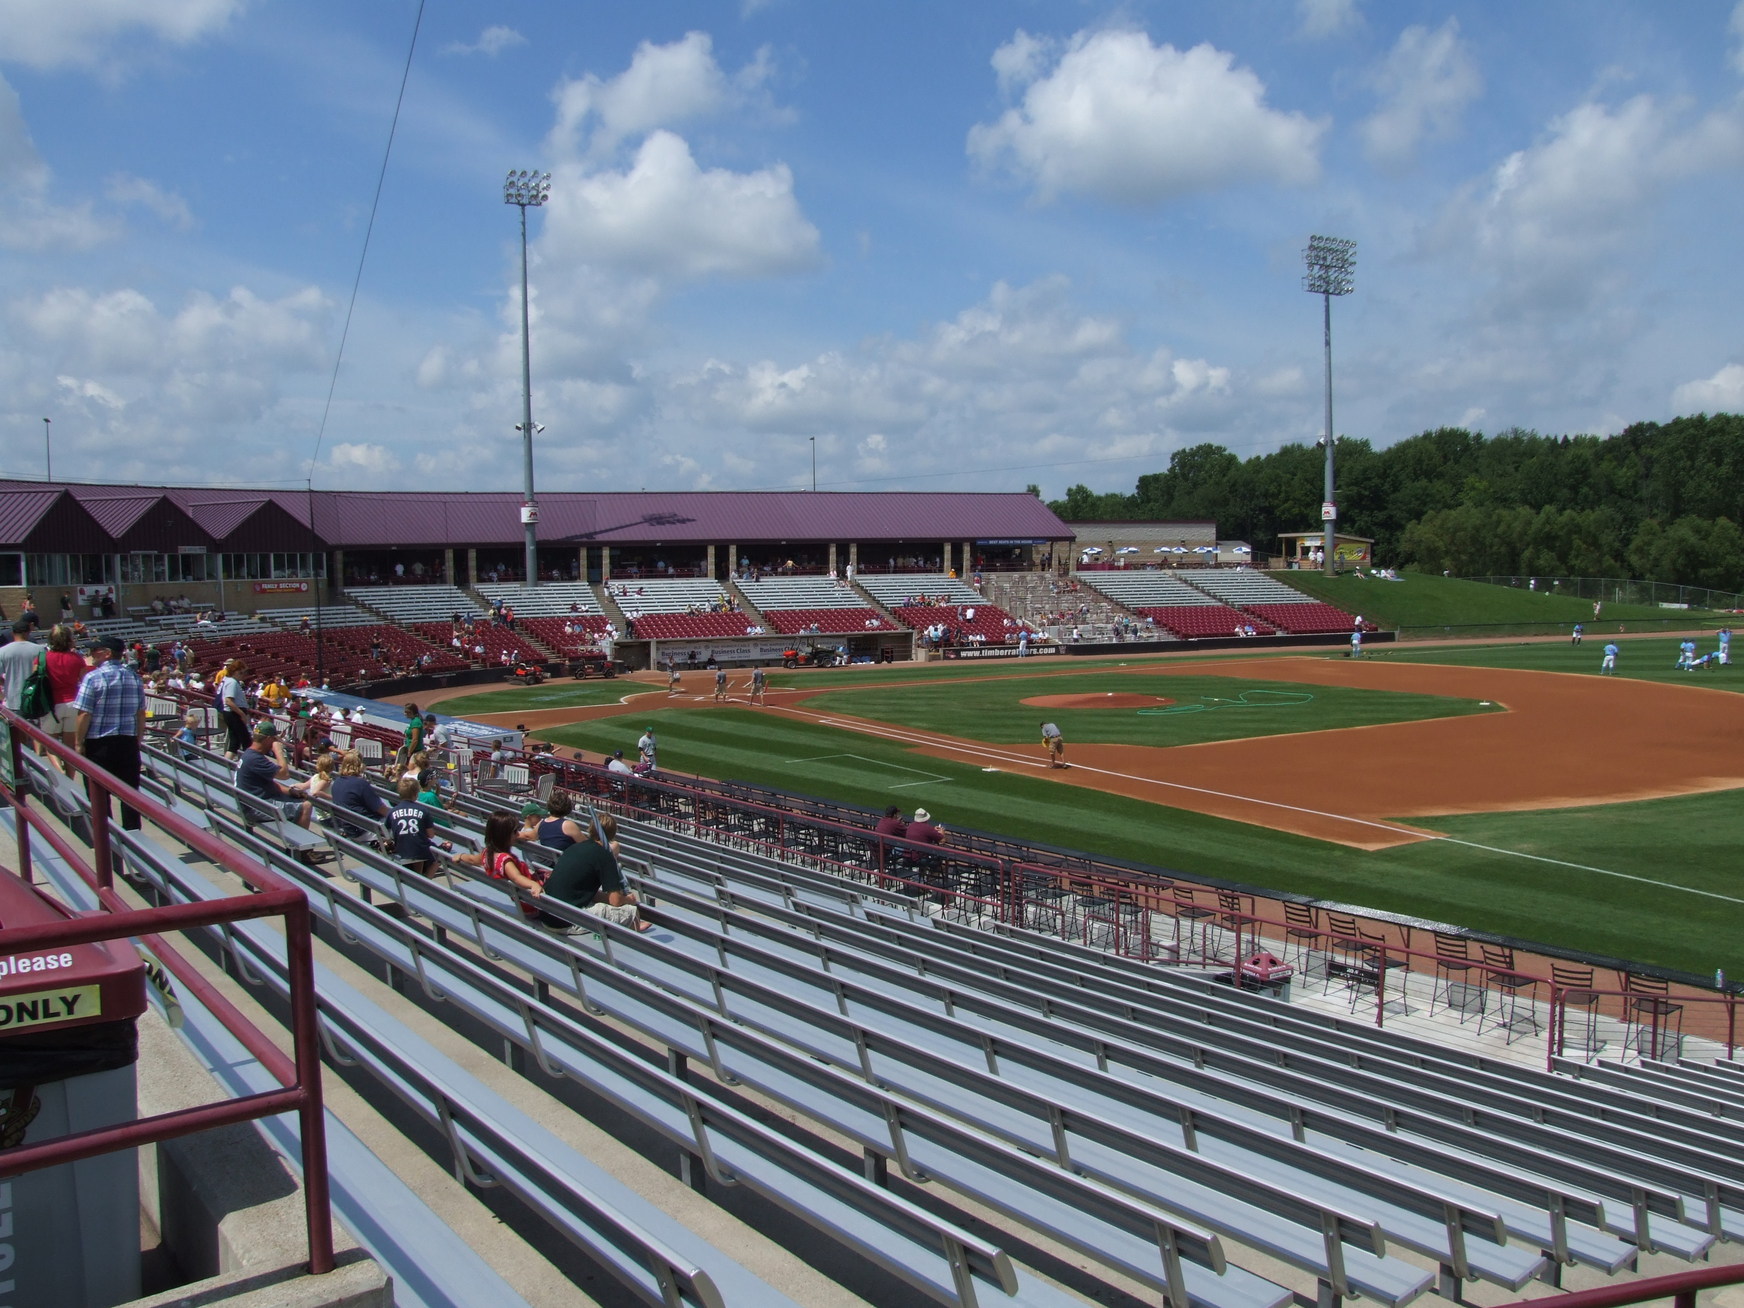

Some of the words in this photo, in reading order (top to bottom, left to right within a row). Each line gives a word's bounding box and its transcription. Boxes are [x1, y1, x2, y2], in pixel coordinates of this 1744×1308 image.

[960, 647, 1055, 657] www.timberraters.com
[392, 808, 424, 819] FIELDER
[397, 818, 420, 835] 28
